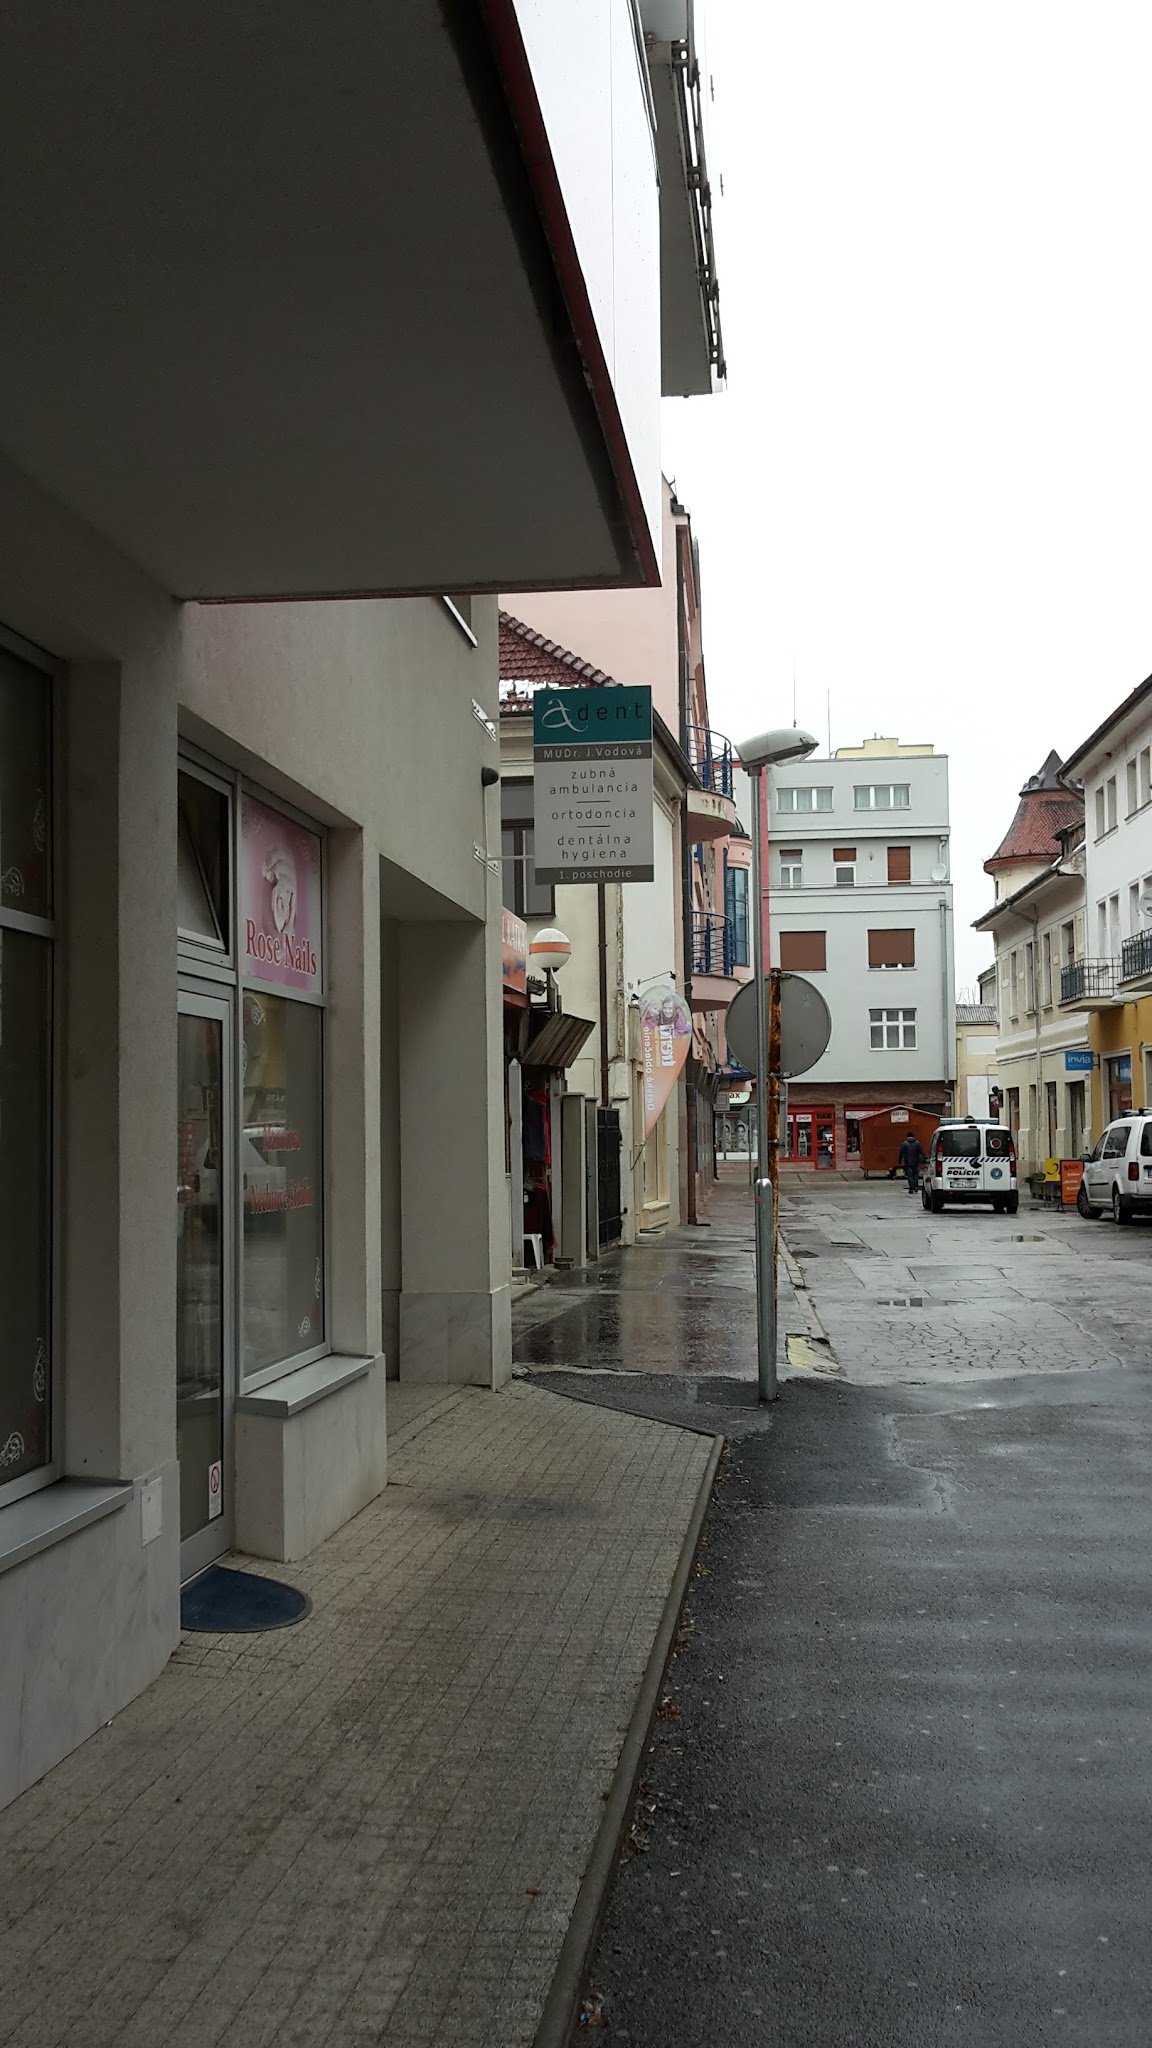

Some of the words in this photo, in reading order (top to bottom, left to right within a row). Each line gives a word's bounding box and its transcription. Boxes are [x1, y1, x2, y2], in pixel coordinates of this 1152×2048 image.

[543, 748, 581, 759] MUDr.
[571, 767, 616, 779] zubná
[549, 782, 638, 795] ambulancia
[551, 808, 636, 820] ortodoncia
[557, 834, 631, 846] dentálna
[562, 849, 627, 861] hygiena
[245, 917, 280, 965] Rose
[284, 931, 318, 976] Nails
[1067, 1054, 1091, 1065] invia
[946, 1168, 980, 1176] POLÍCIA
